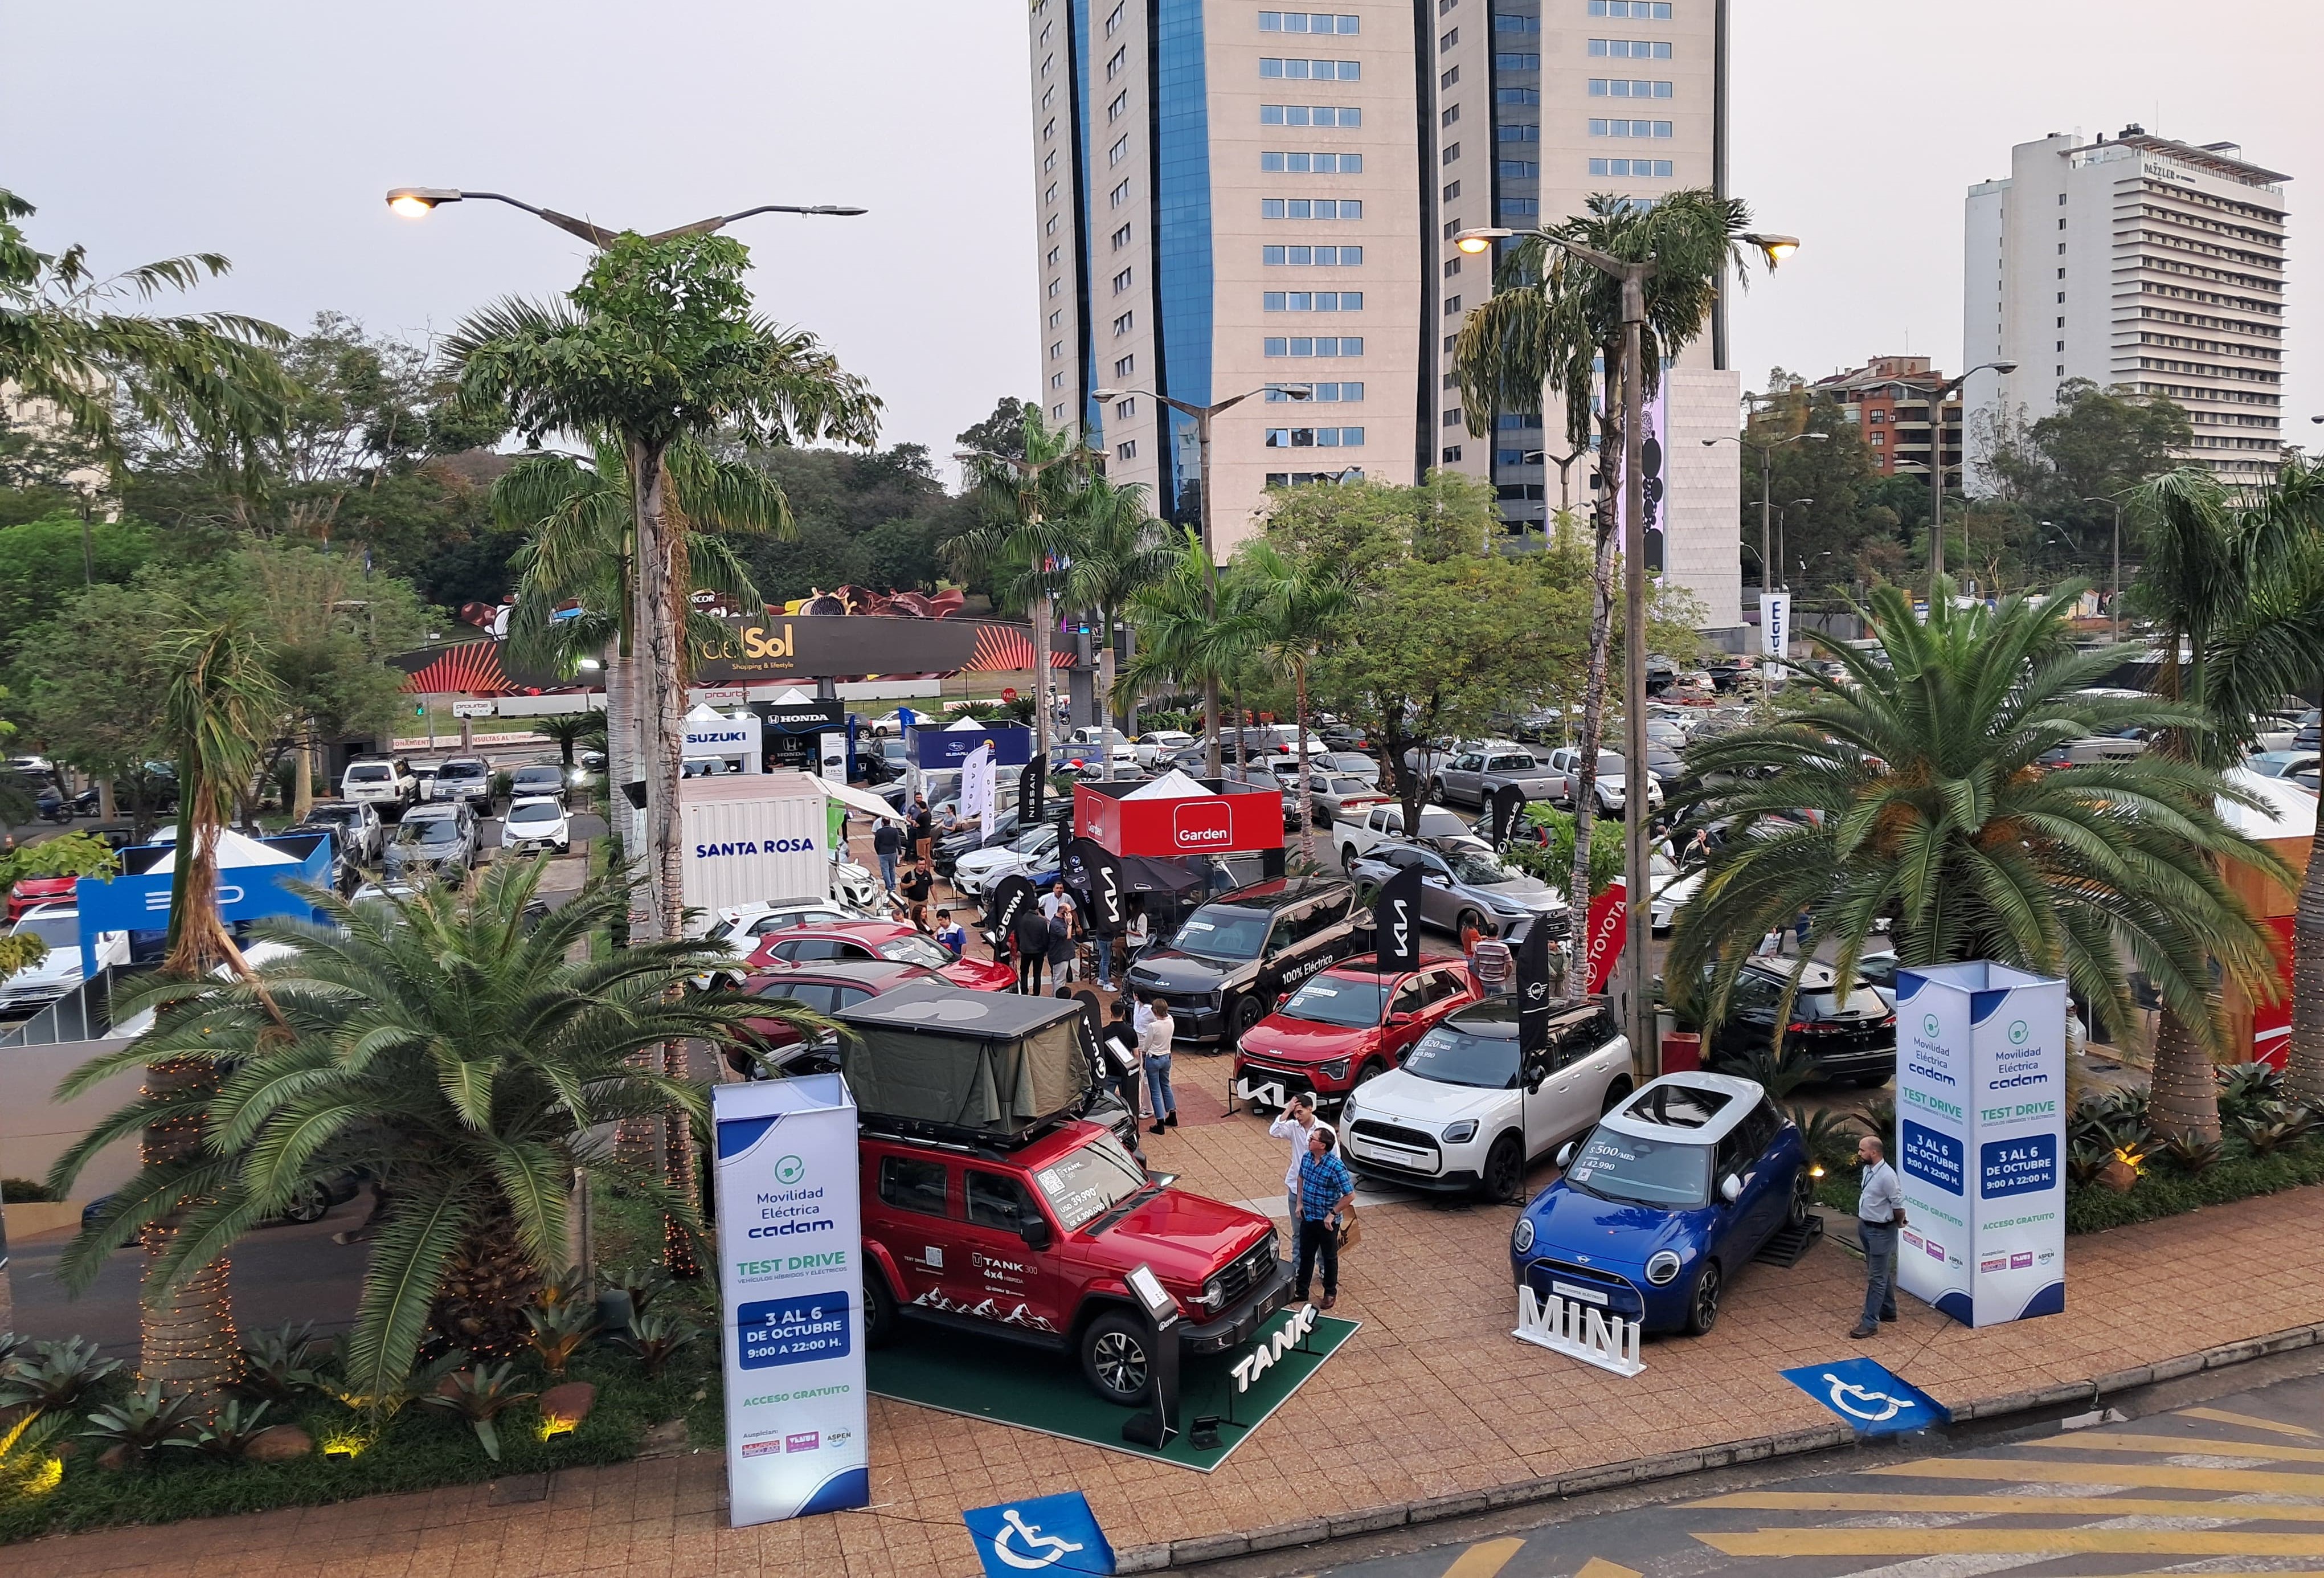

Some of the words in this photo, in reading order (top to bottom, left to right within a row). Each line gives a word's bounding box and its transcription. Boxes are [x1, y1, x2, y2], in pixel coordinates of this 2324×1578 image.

[2145, 163, 2175, 179] DAZZLER
[732, 663, 762, 671] Shopping
[770, 661, 794, 669] lifestyle
[780, 714, 829, 723] HONDA
[686, 731, 747, 744] SUZUKI
[967, 762, 977, 810] VOLVO
[1087, 820, 1103, 837] Garden
[1180, 829, 1227, 842] Garden
[696, 842, 758, 859] SANTA
[764, 838, 815, 853] ROSA
[1001, 889, 1025, 926] GWM
[1589, 901, 1626, 960] TOYOTA
[1282, 967, 1303, 986] 100%
[1304, 954, 1333, 975] Eléctrico
[1914, 1036, 1950, 1056] Movilidad
[1996, 1046, 2041, 1061] Movilidad
[1916, 1050, 1947, 1069] Eléctrica
[1998, 1061, 2039, 1074] Eléctrica
[1909, 1063, 1955, 1087] cadam
[1989, 1074, 2048, 1090] cadam
[1902, 1086, 1927, 1104] TEST
[1929, 1095, 1962, 1118] DRIVE
[1981, 1106, 2012, 1121] TEST
[2015, 1100, 2056, 1119] DRIVE
[1595, 1145, 1636, 1162] 500/MES
[1917, 1134, 1923, 1146] 3
[1925, 1138, 1939, 1152] AL
[1941, 1144, 1949, 1156] 6
[1999, 1151, 2007, 1163] 3
[2010, 1148, 2028, 1160] AL
[2030, 1146, 2039, 1158] 6
[1063, 1161, 1085, 1174] TANK
[1587, 1160, 1615, 1171] 42.990
[1907, 1143, 1918, 1155] DE
[1920, 1149, 1959, 1173] OCTUBRE
[1986, 1167, 2000, 1176] DE
[2003, 1158, 2052, 1174] OCTUBRE
[1907, 1157, 1922, 1170] 9:00
[1923, 1163, 1929, 1173] A
[1930, 1167, 1950, 1182] 22:00
[1986, 1180, 2006, 1190] 9:00
[2007, 1178, 2015, 1187] A
[2016, 1175, 2040, 1185] 22:00
[758, 1187, 824, 1204] Movilidad
[1071, 1187, 1097, 1207] 39.990
[762, 1205, 820, 1220] Eléctrica
[1077, 1202, 1106, 1223] 4.300.000
[1904, 1195, 1929, 1211] ACCESO
[1930, 1206, 1963, 1227] GRATUITO
[748, 1220, 834, 1239] cadam
[1982, 1219, 2014, 1230] ACCESO
[2016, 1212, 2055, 1225] GRATUITO
[737, 1258, 783, 1276] TEST
[788, 1250, 846, 1270] DRIVE
[983, 1257, 1024, 1272] TANK
[1025, 1265, 1038, 1275] 300
[738, 1275, 773, 1284] VEHÍCULOS
[774, 1271, 804, 1280] HÍBRIDOS
[984, 1269, 1004, 1281] 4x4
[765, 1313, 777, 1326] 3
[781, 1309, 807, 1324] AL
[811, 1306, 823, 1320] 6
[747, 1330, 768, 1343] DE
[771, 1320, 842, 1339] OCTUBRE
[1519, 1285, 1640, 1371] MINI
[747, 1346, 776, 1359] 9:00
[779, 1344, 789, 1354] A
[791, 1339, 826, 1352] 22:00
[829, 1337, 842, 1348] H.
[1231, 1303, 1313, 1393] TANK
[743, 1393, 790, 1407] ACCESO
[792, 1384, 850, 1400] GRATUITO
[827, 1432, 852, 1442] ASPEN
